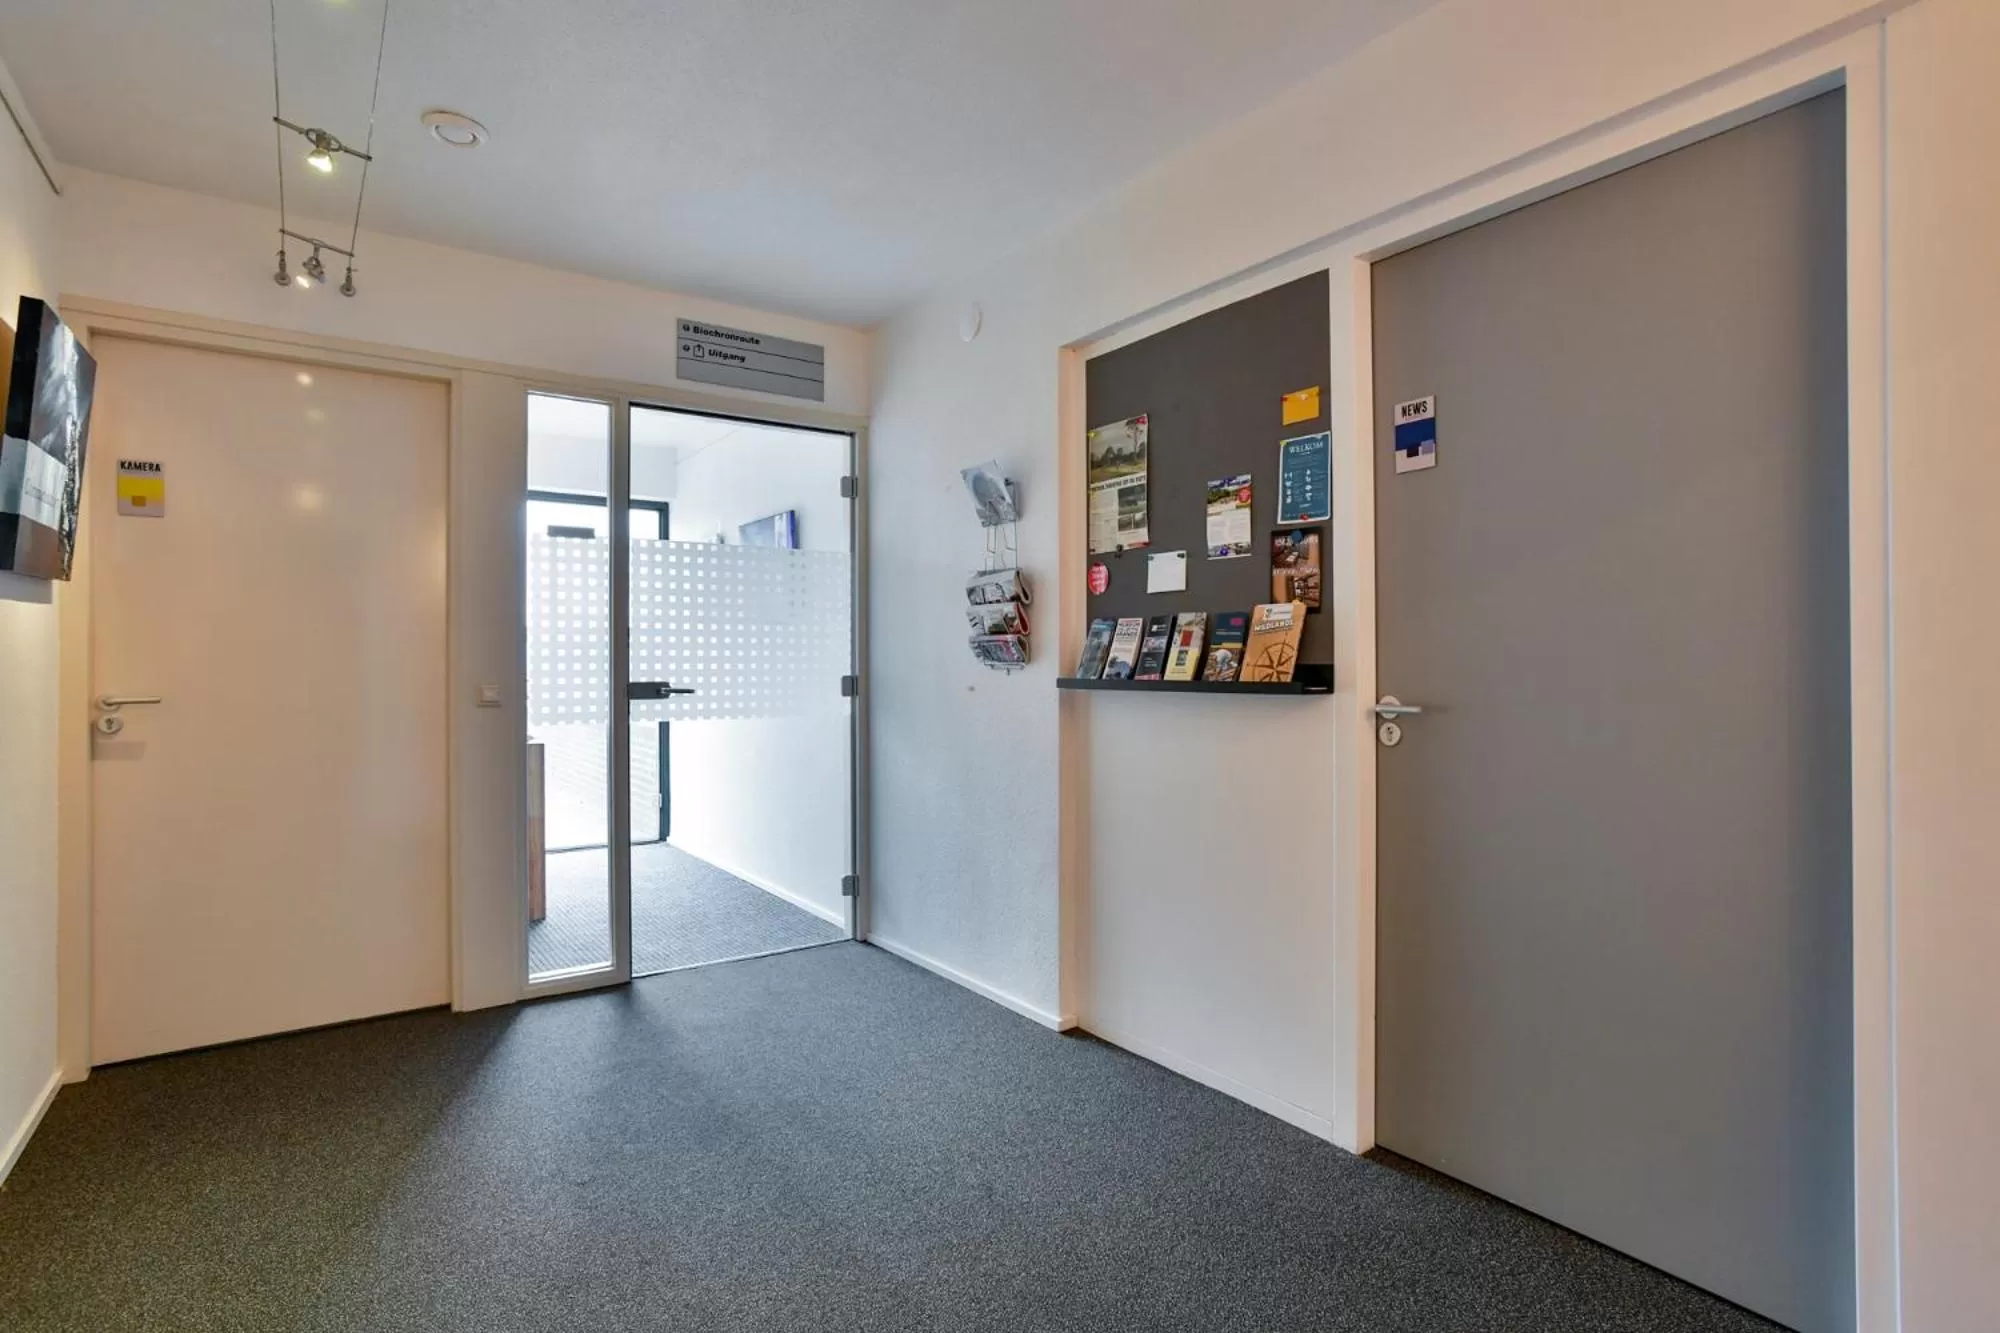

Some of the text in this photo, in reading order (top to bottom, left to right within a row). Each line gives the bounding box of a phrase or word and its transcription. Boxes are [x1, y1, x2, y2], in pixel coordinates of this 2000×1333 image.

[693, 326, 760, 345] Biochronroute
[708, 348, 746, 363] Uitgang
[1401, 400, 1428, 419] NEWS
[1289, 441, 1323, 454] WELKOM
[120, 460, 161, 472] KAMERA
